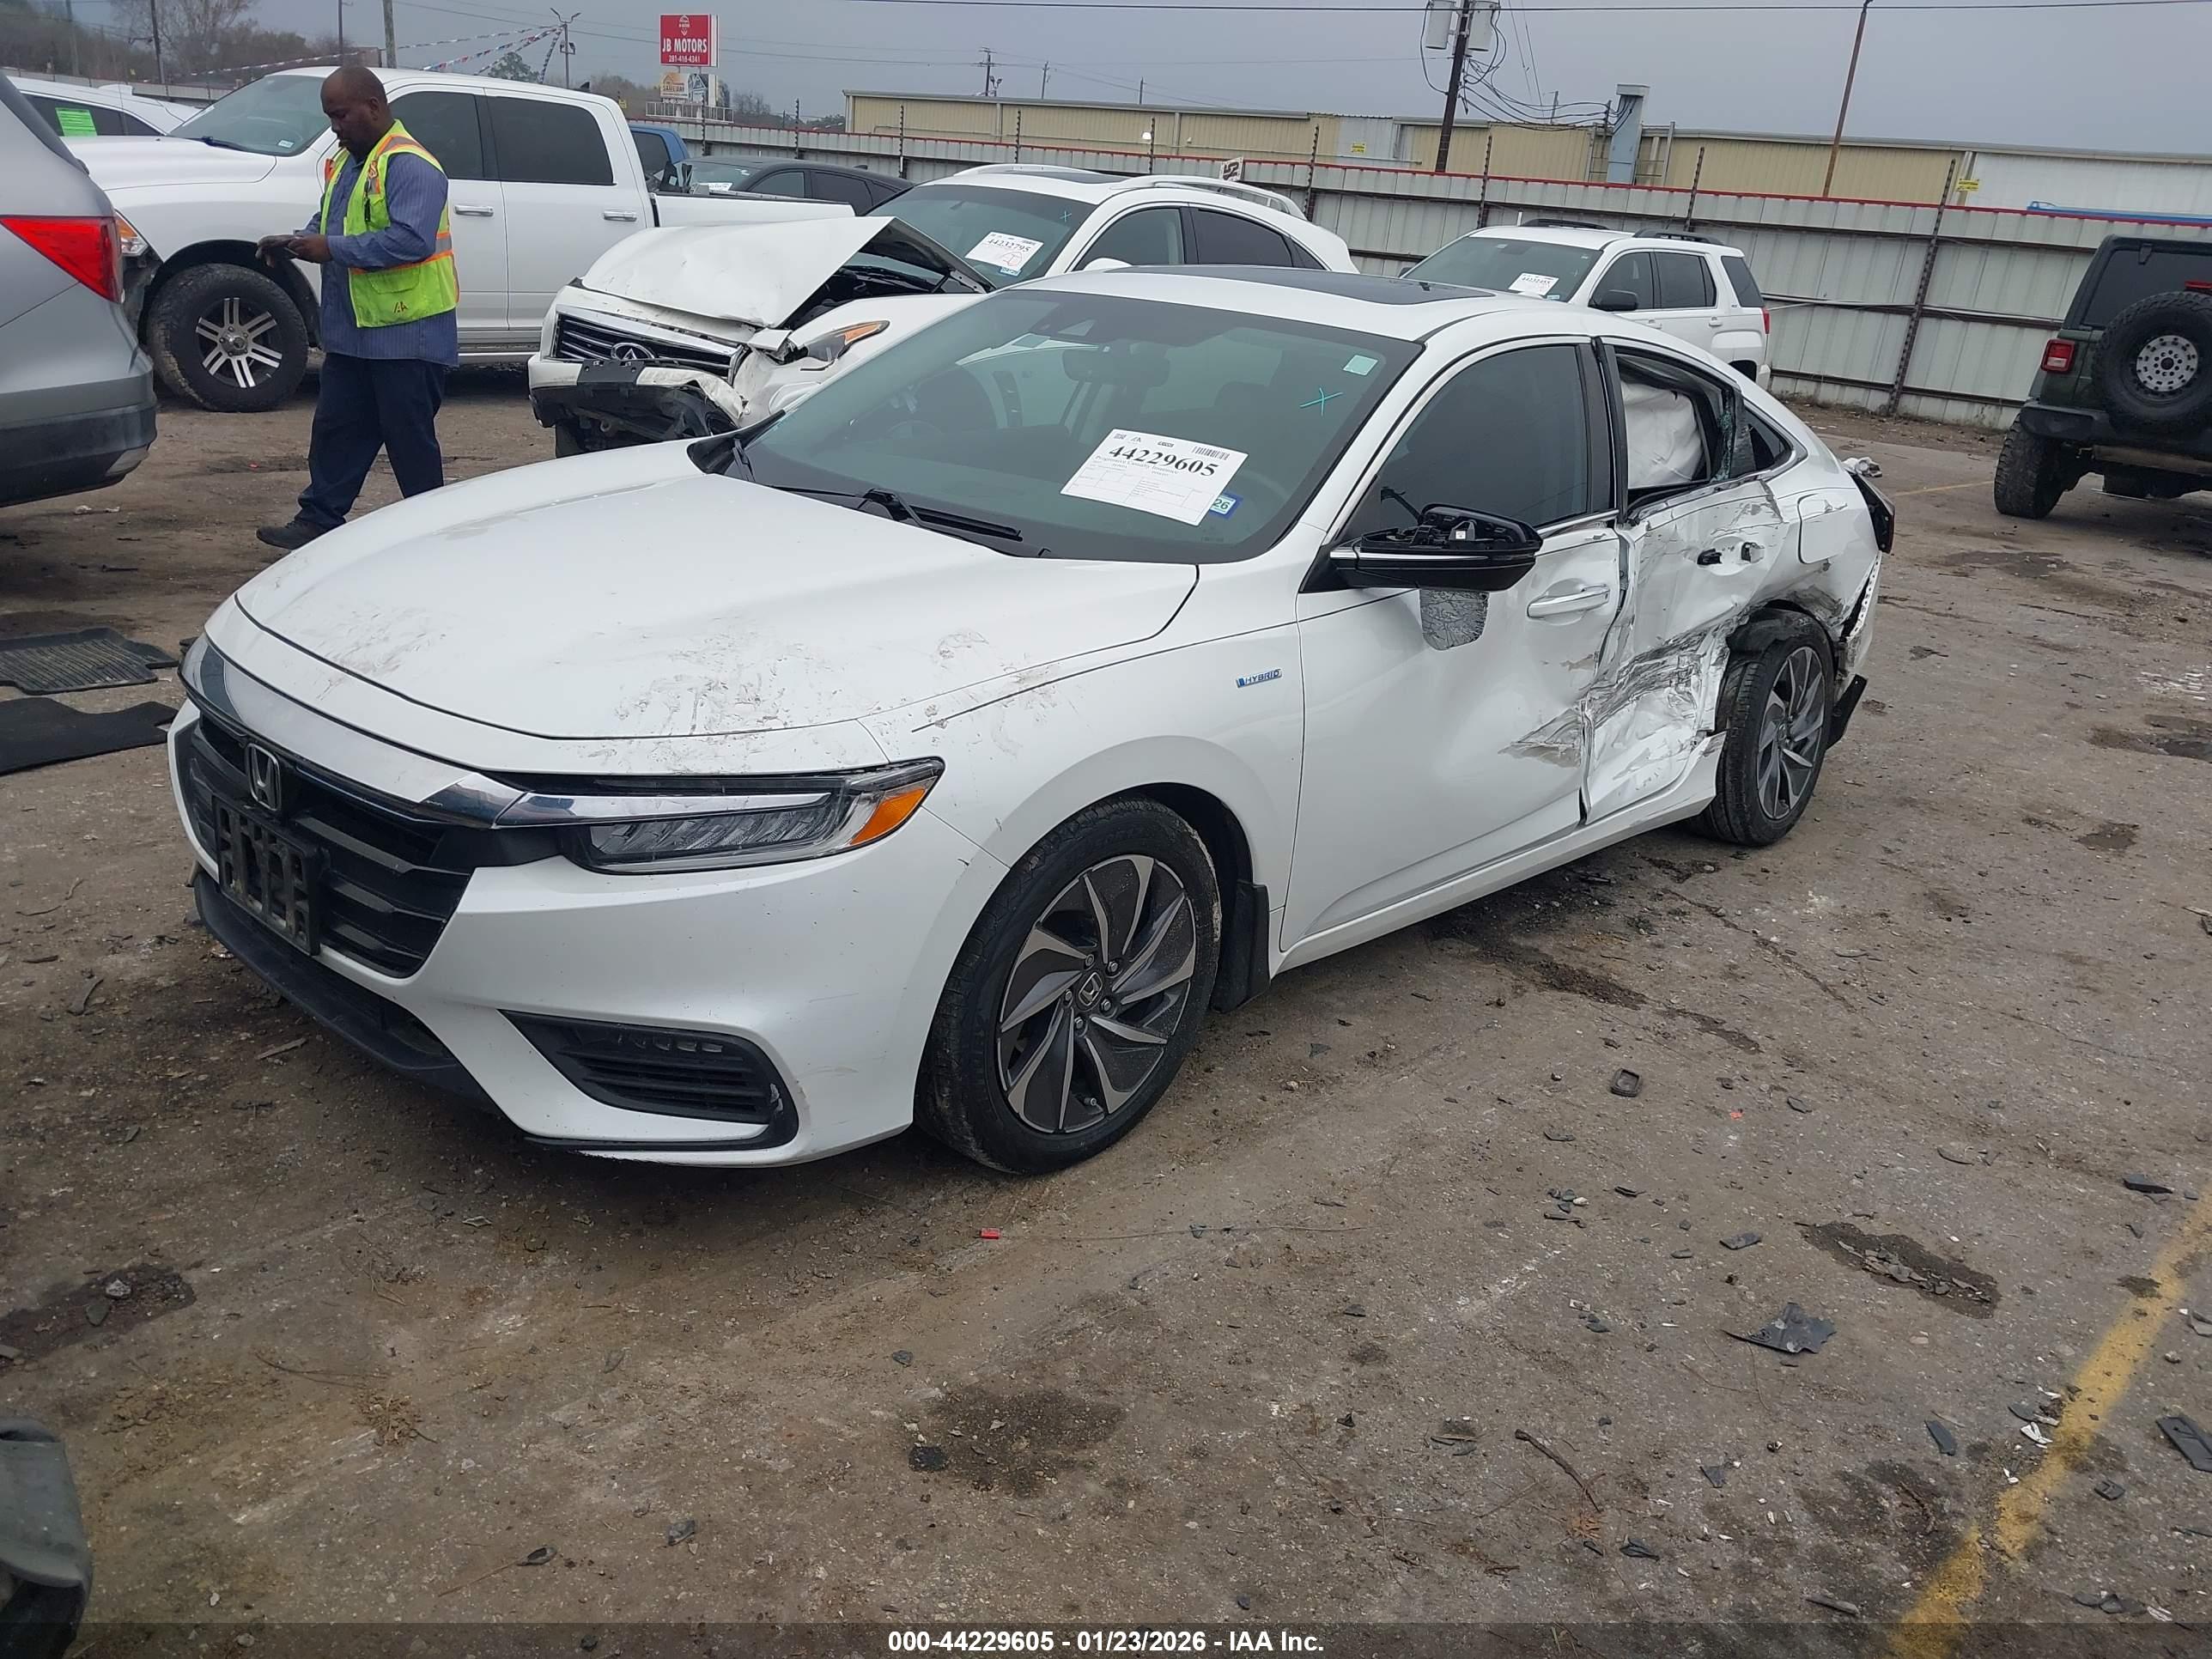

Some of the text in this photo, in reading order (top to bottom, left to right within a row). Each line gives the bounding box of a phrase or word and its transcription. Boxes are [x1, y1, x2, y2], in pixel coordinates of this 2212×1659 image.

[662, 38, 708, 53] JB MOTORS
[668, 54, 701, 63] 281-416-4341
[988, 239, 1031, 252] 44232795
[1109, 445, 1220, 477] 44229605
[1212, 498, 1231, 510] 26
[1245, 668, 1280, 684] HYBRID
